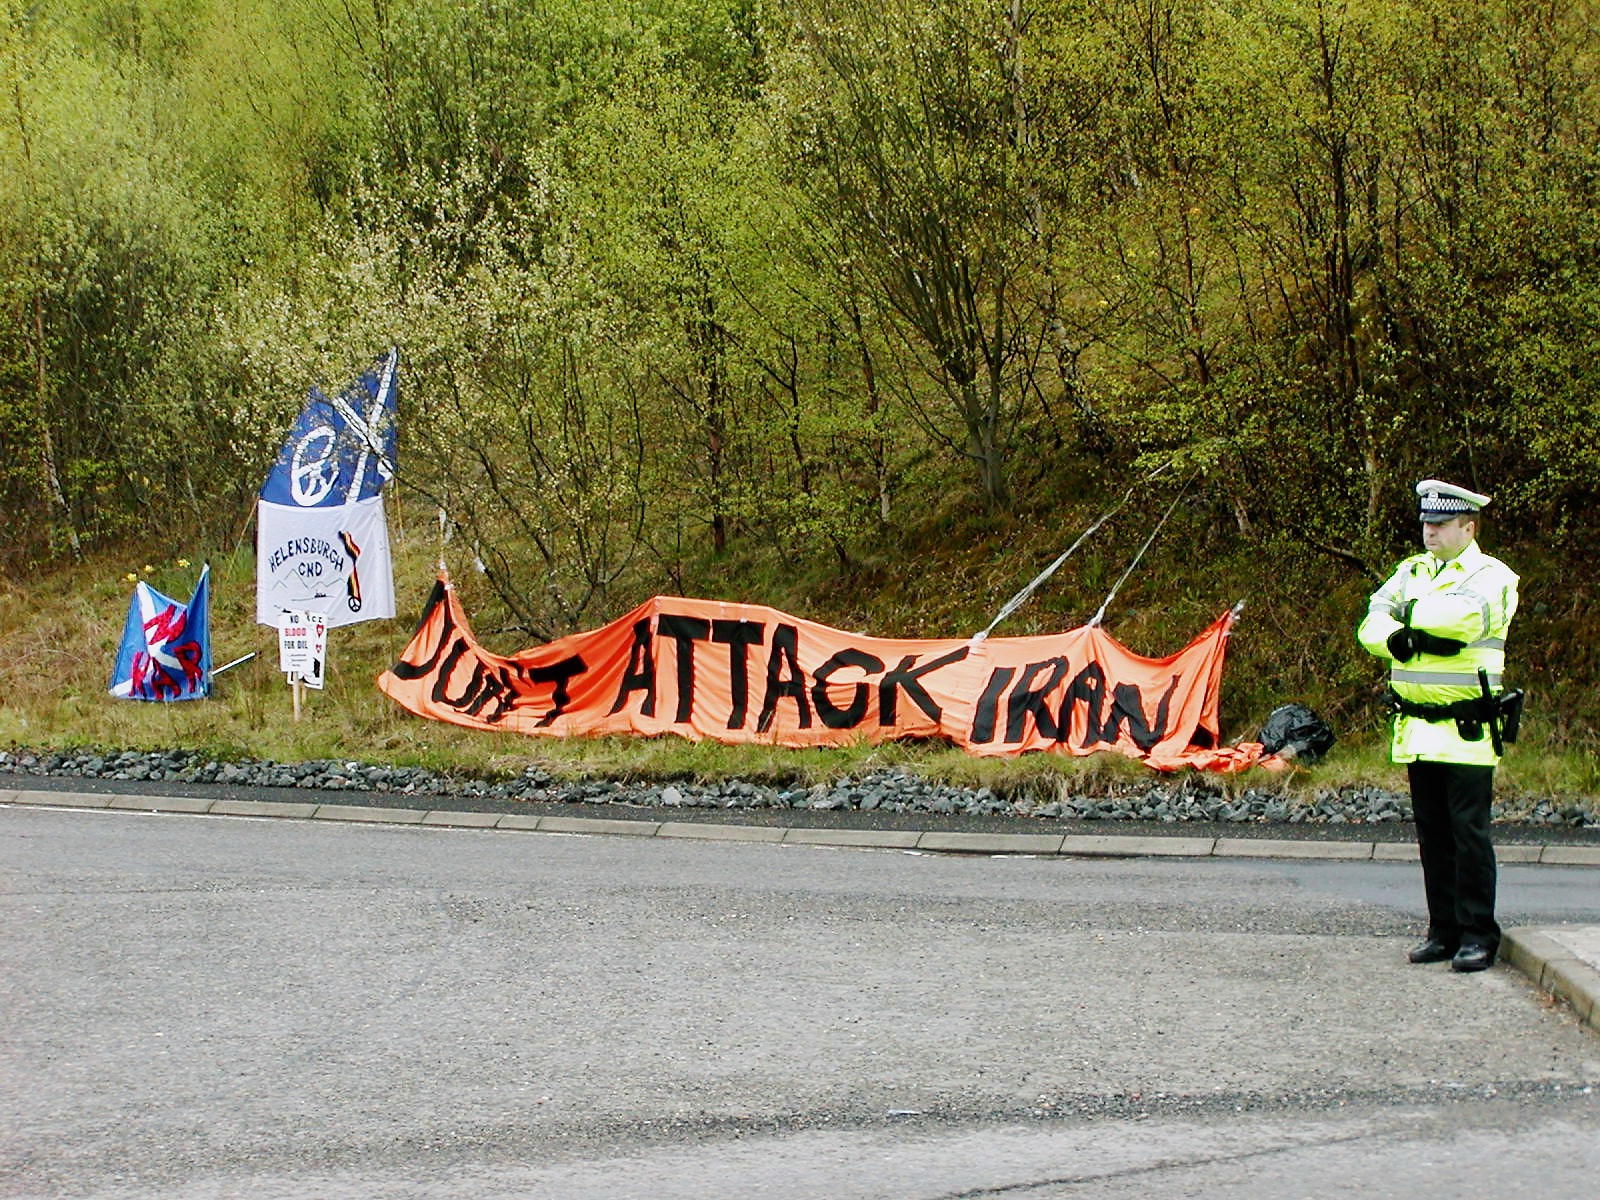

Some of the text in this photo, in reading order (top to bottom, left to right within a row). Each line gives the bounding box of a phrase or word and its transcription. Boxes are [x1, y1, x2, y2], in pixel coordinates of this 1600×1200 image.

[268, 537, 344, 573] HELENSBURGH
[298, 561, 323, 578] CND
[290, 614, 299, 624] NO
[284, 628, 306, 637] BLOOD
[284, 640, 308, 649] FOR OIL
[603, 613, 970, 733] ATTACK
[970, 655, 1182, 753] IRAN
